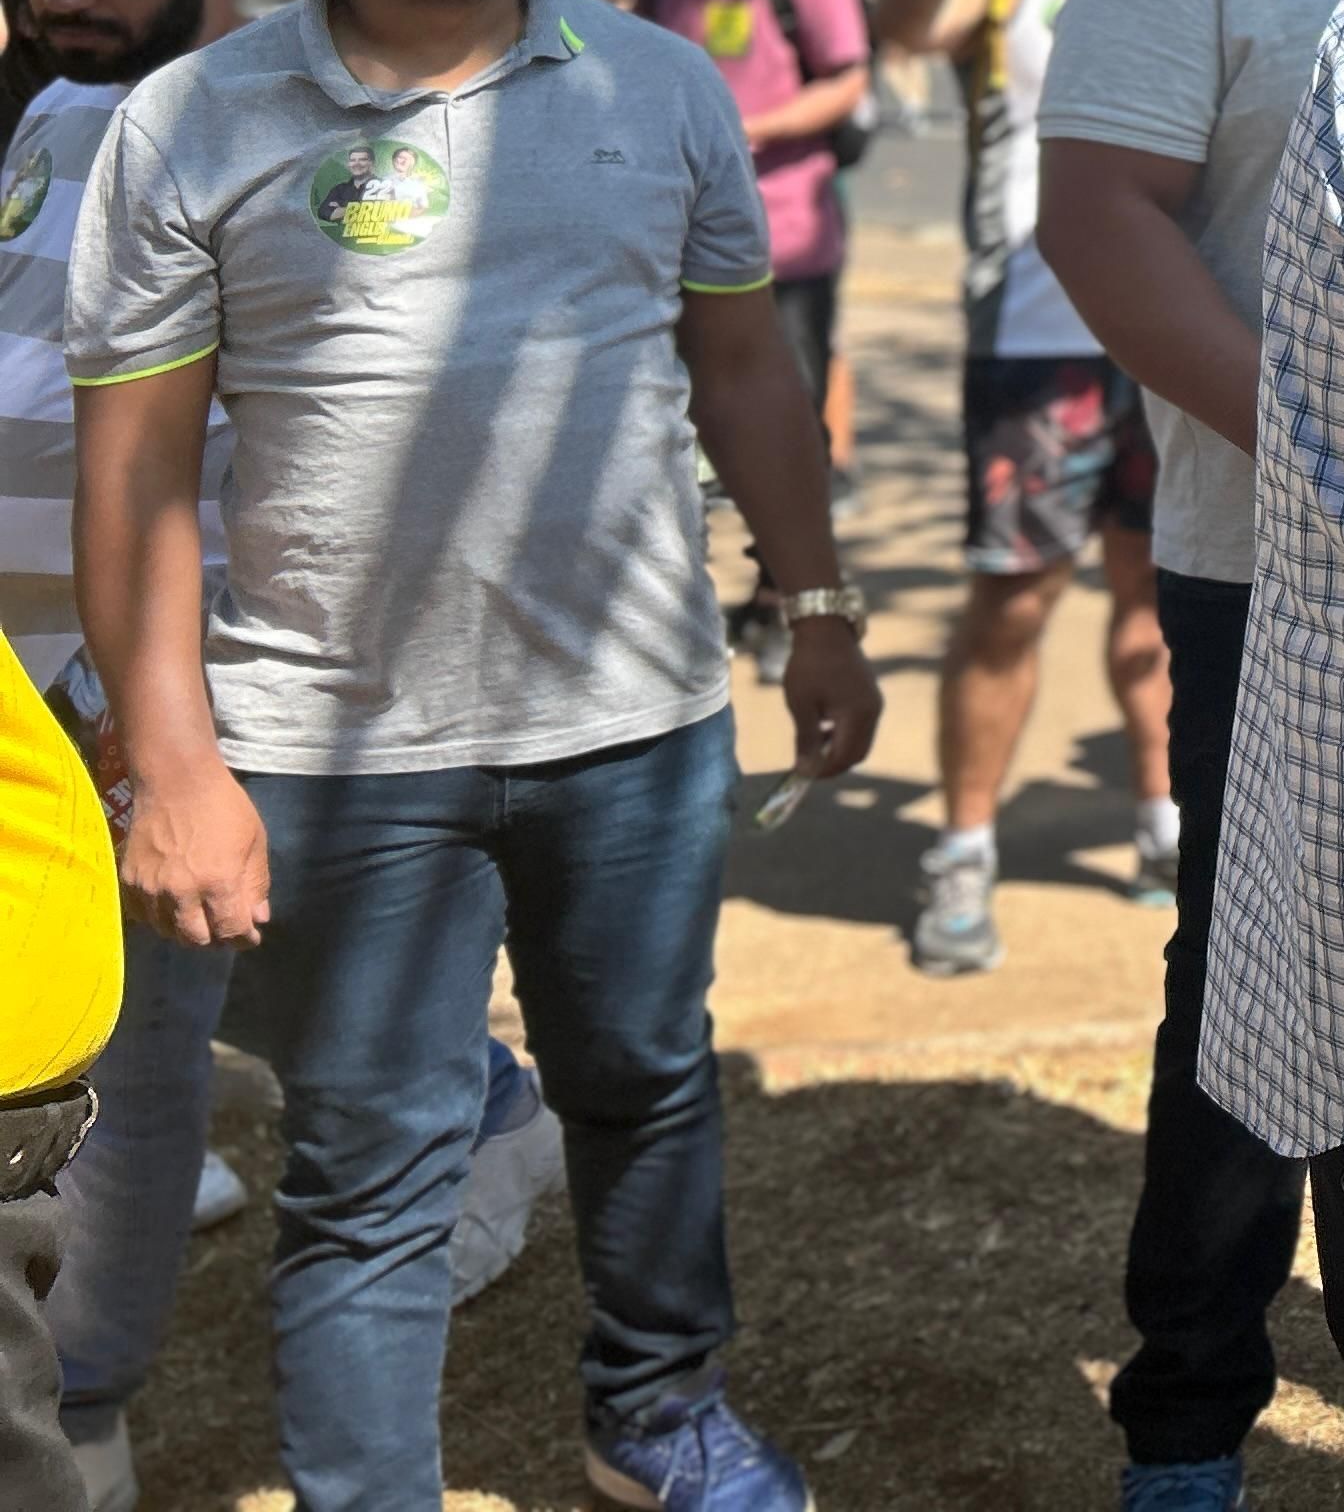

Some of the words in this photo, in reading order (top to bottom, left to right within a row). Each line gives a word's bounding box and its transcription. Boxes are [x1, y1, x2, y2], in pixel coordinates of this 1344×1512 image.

[361, 178, 394, 201] 22
[343, 200, 412, 223] BRUNO
[341, 221, 390, 238] ENGL
